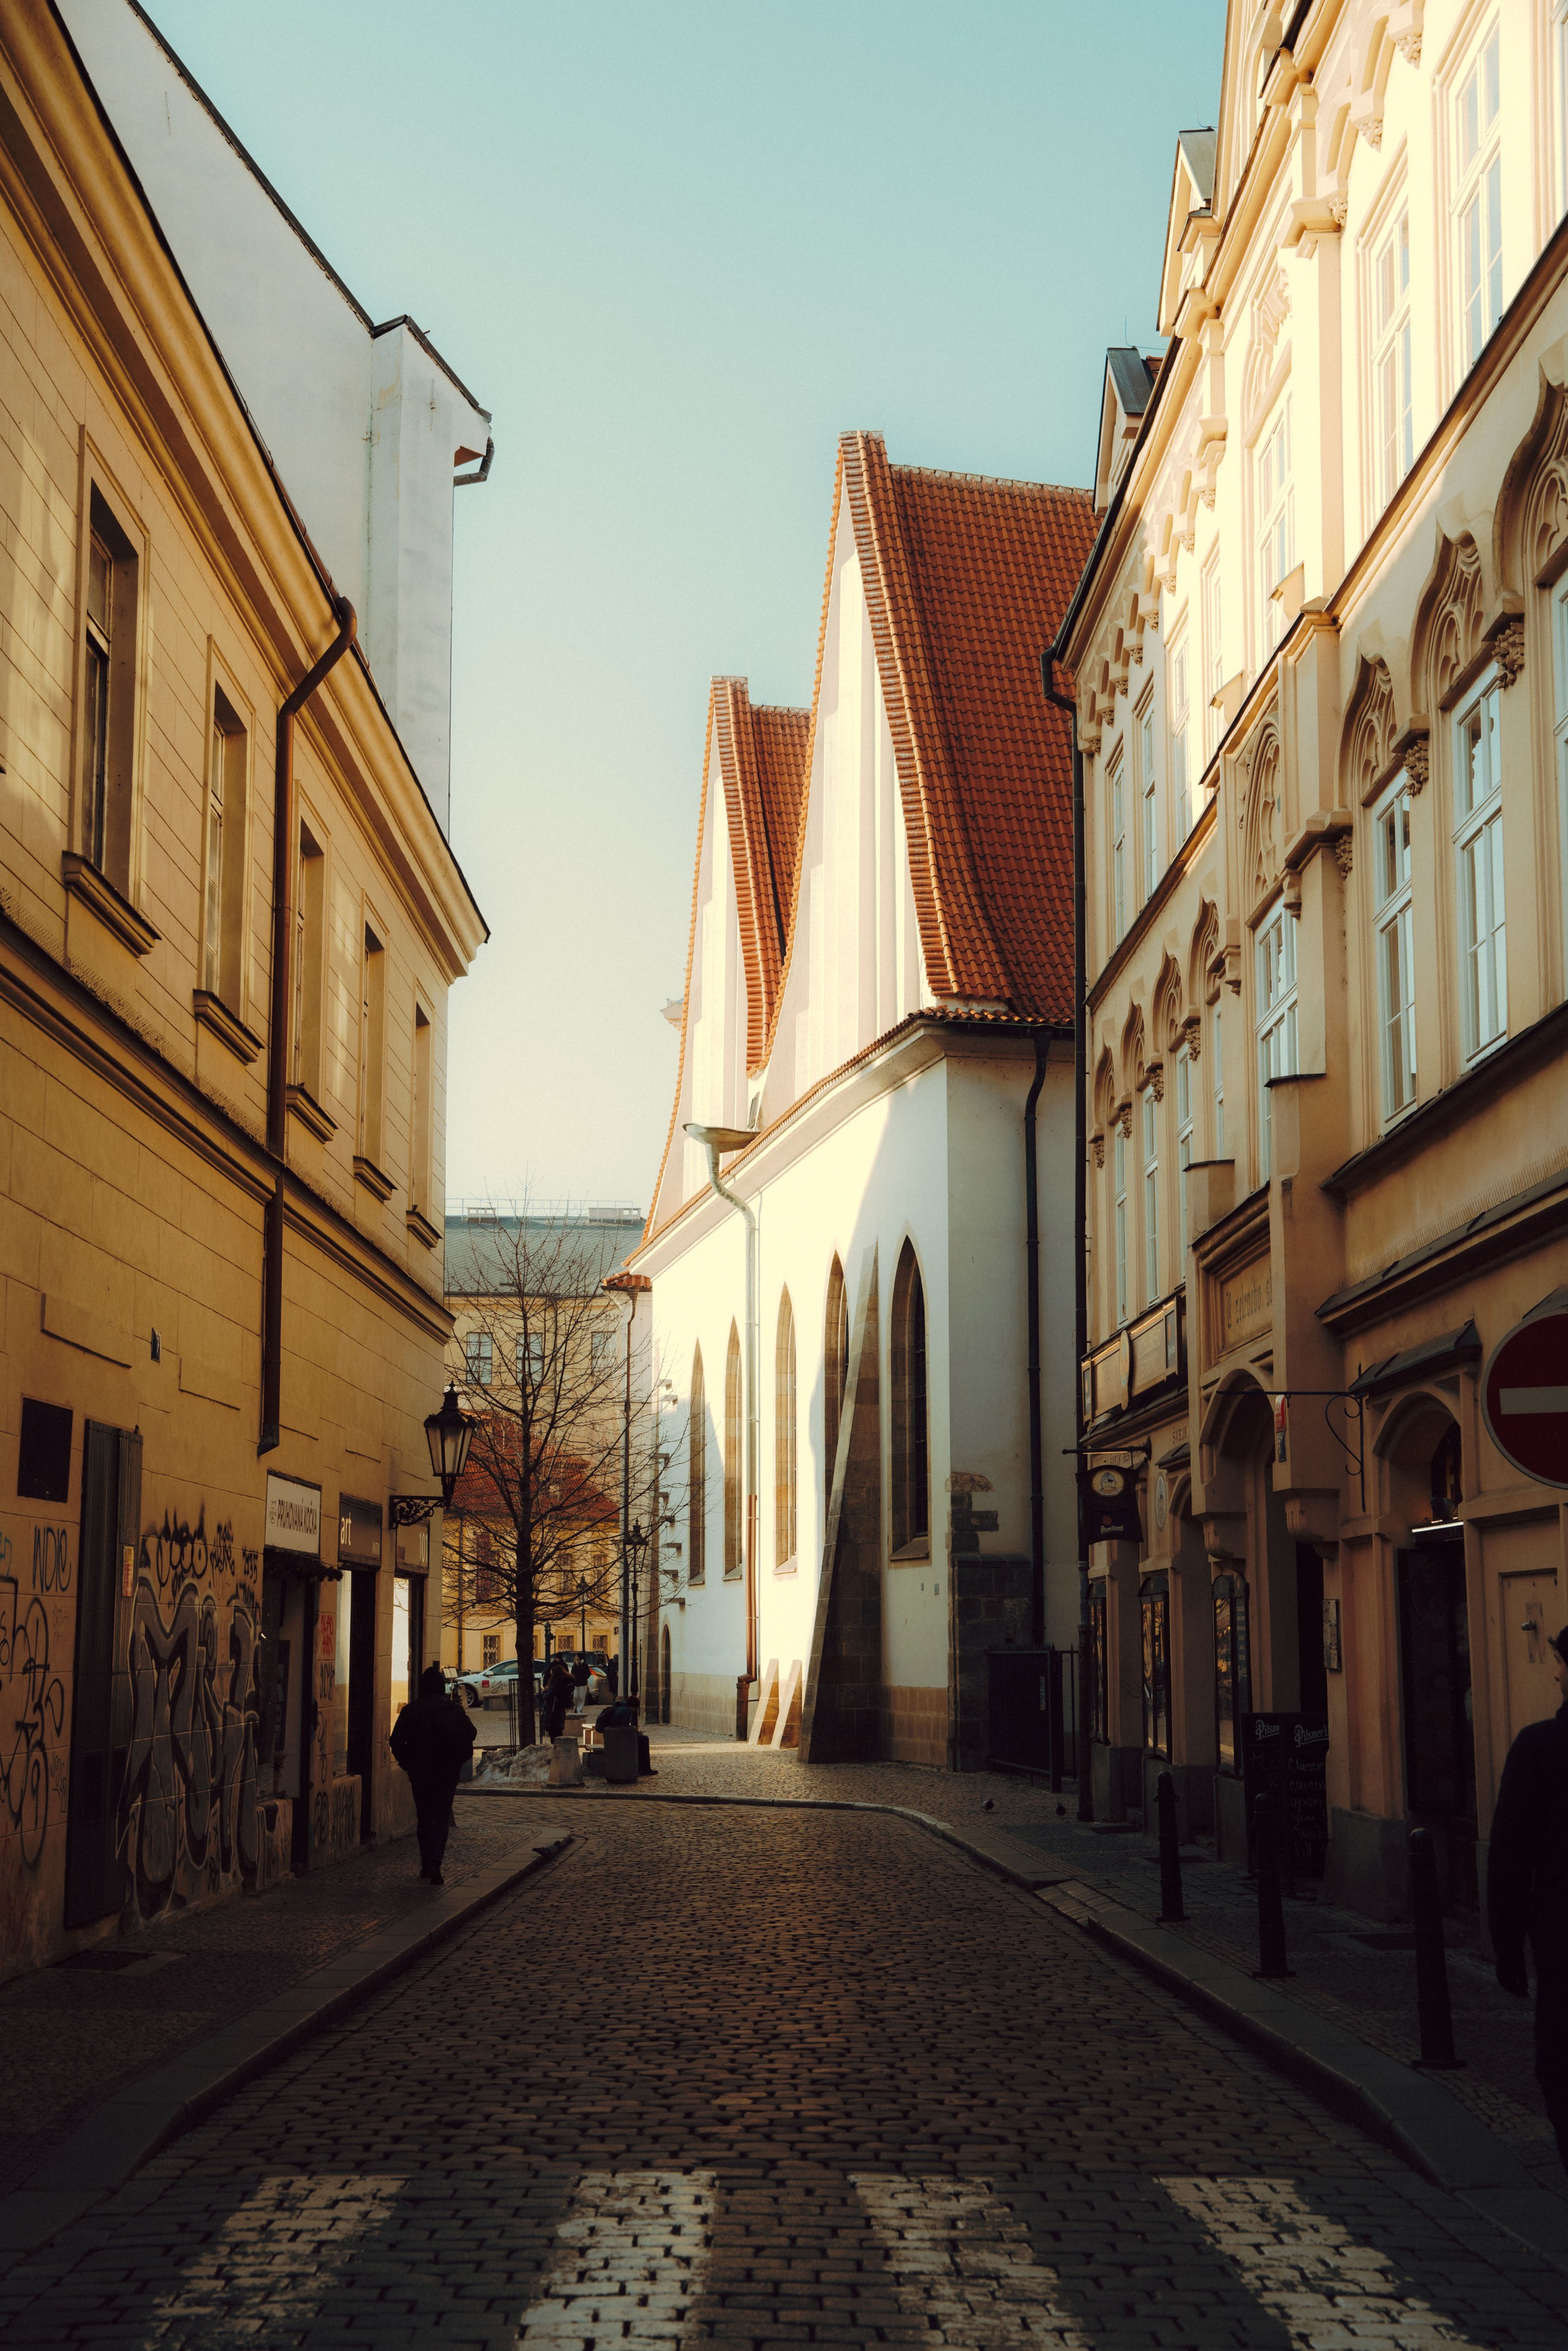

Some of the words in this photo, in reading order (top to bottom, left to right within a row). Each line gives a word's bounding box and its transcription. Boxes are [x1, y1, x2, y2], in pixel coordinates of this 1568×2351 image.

[277, 1498, 304, 1533] PRUHOVANÁ
[303, 1500, 317, 1536] KOČKA
[341, 1512, 352, 1546] art
[419, 1532, 428, 1563] 101
[1288, 1757, 1324, 1772] Classic
[1290, 1797, 1322, 1813] open
[1291, 1813, 1316, 1831] you
